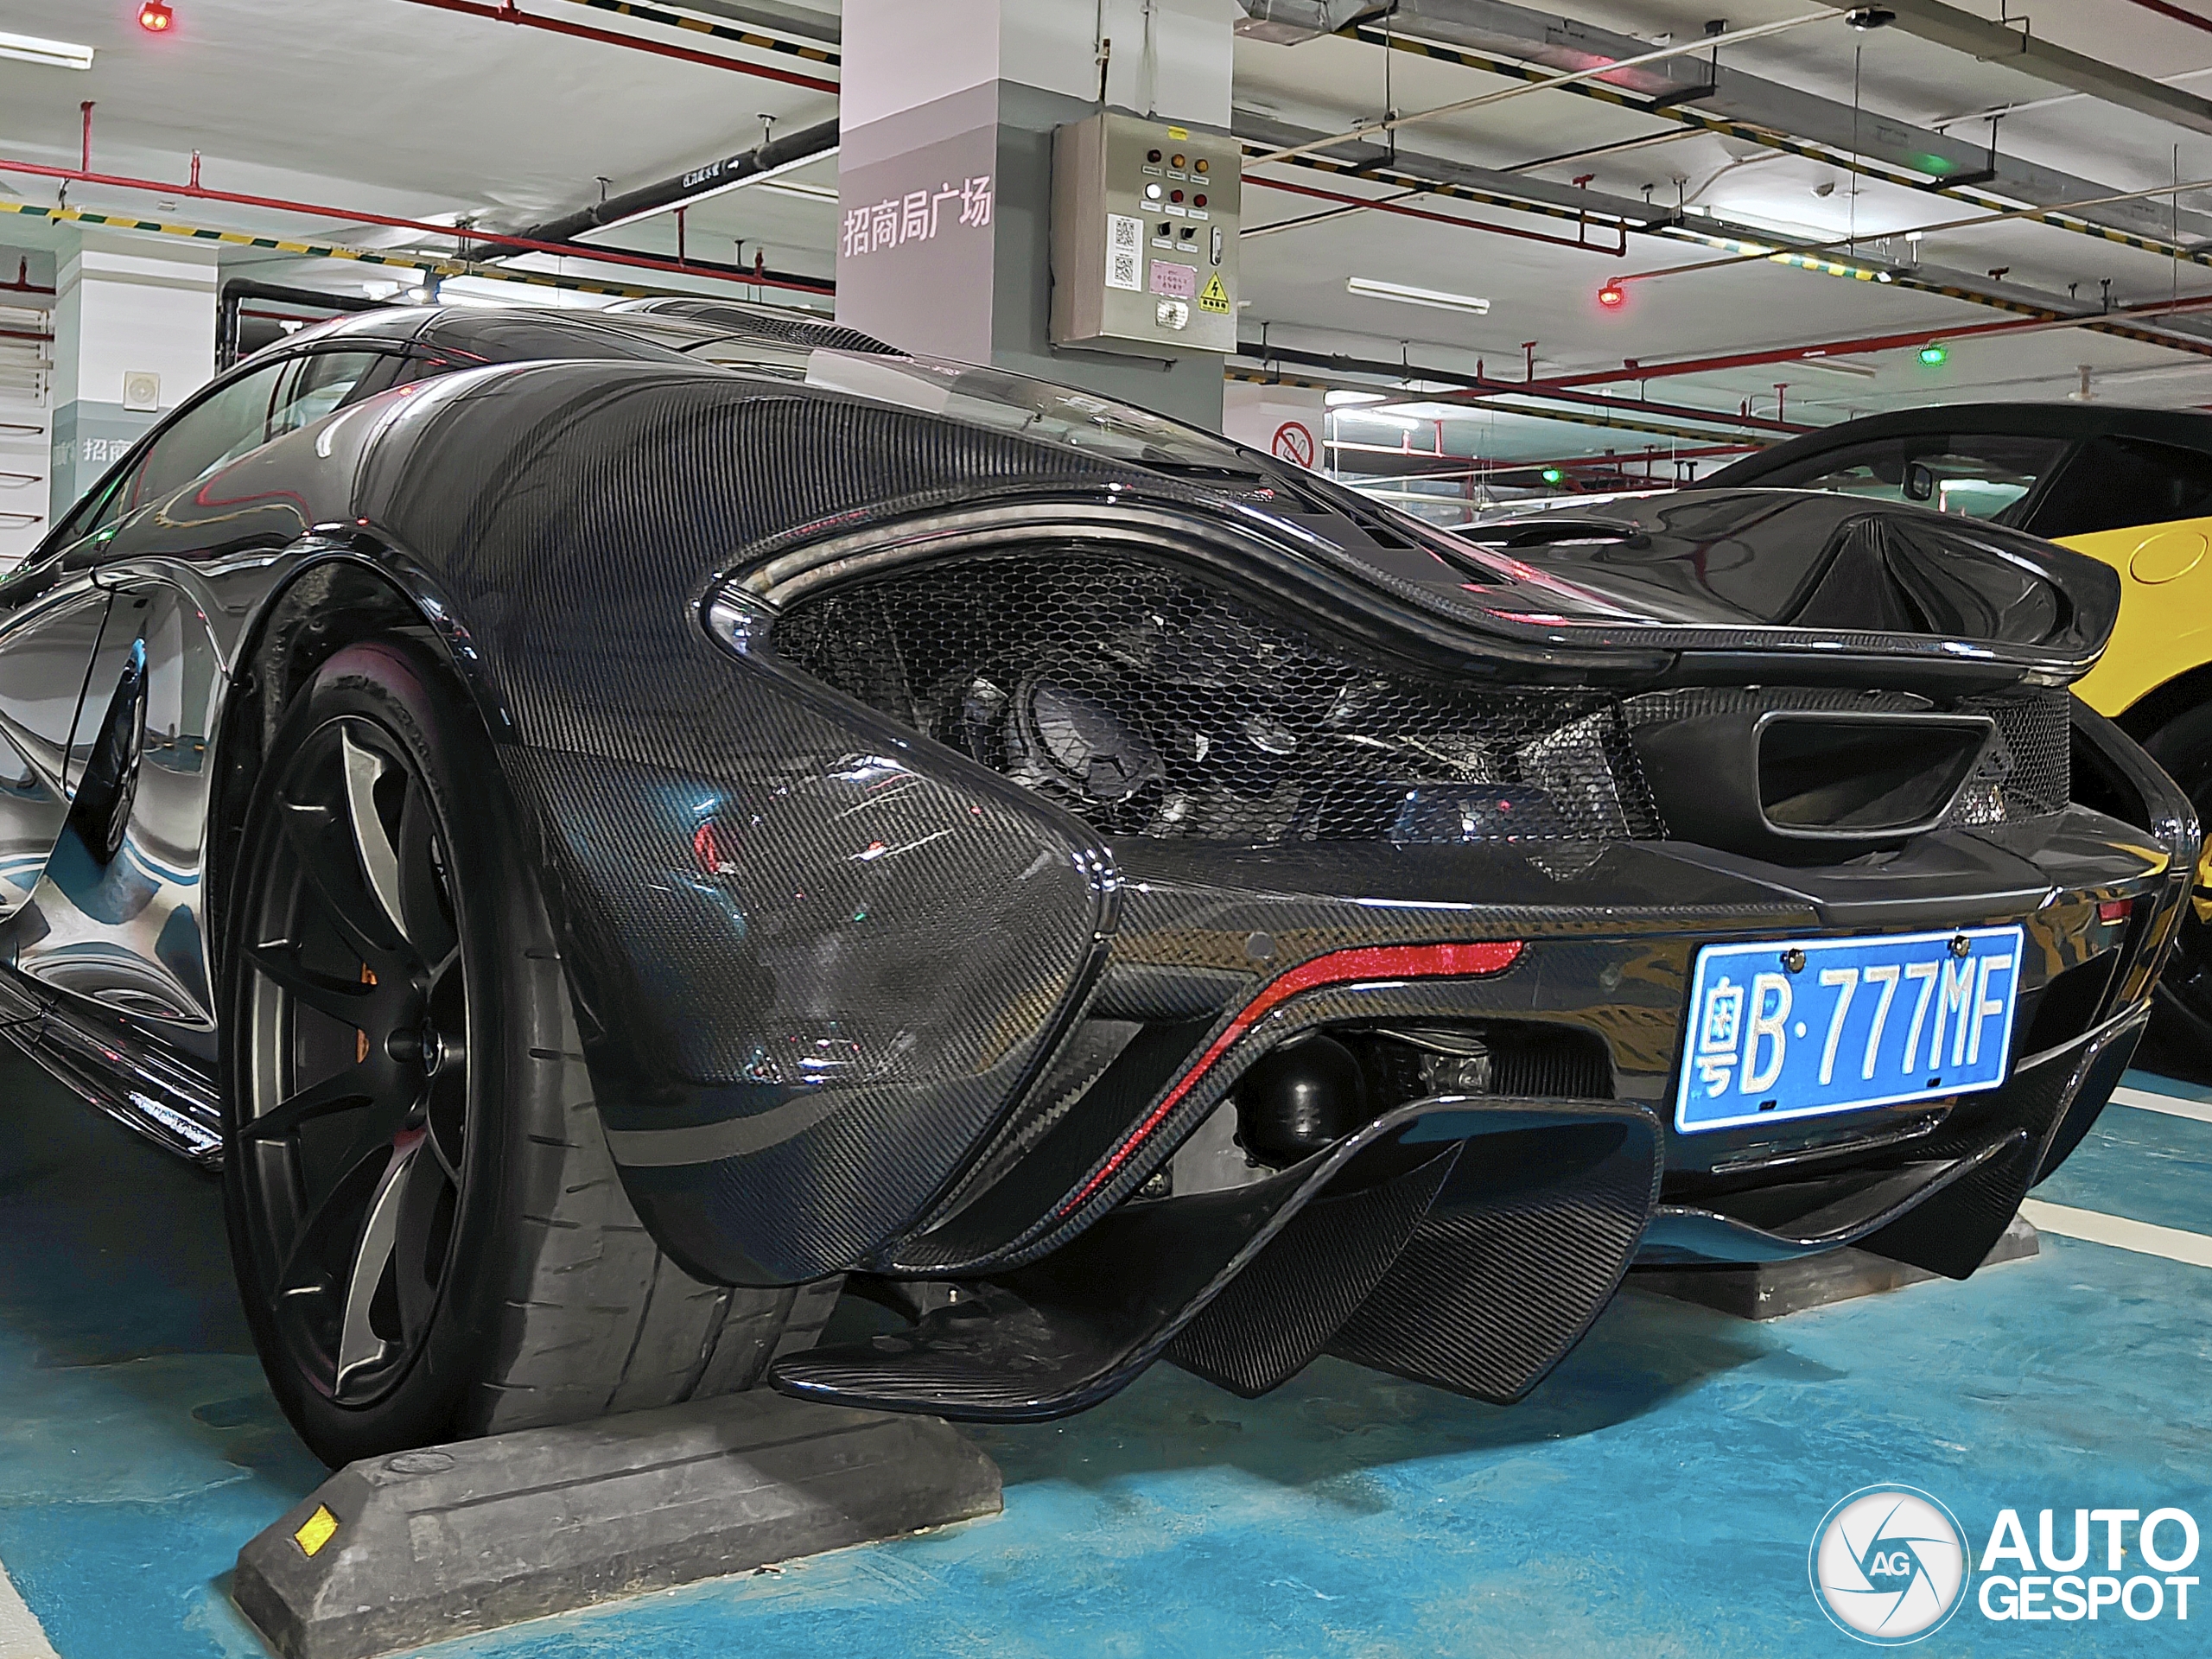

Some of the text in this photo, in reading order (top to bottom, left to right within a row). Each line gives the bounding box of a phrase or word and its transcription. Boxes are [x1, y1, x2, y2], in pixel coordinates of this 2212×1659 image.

[842, 175, 992, 258] 招商局广场
